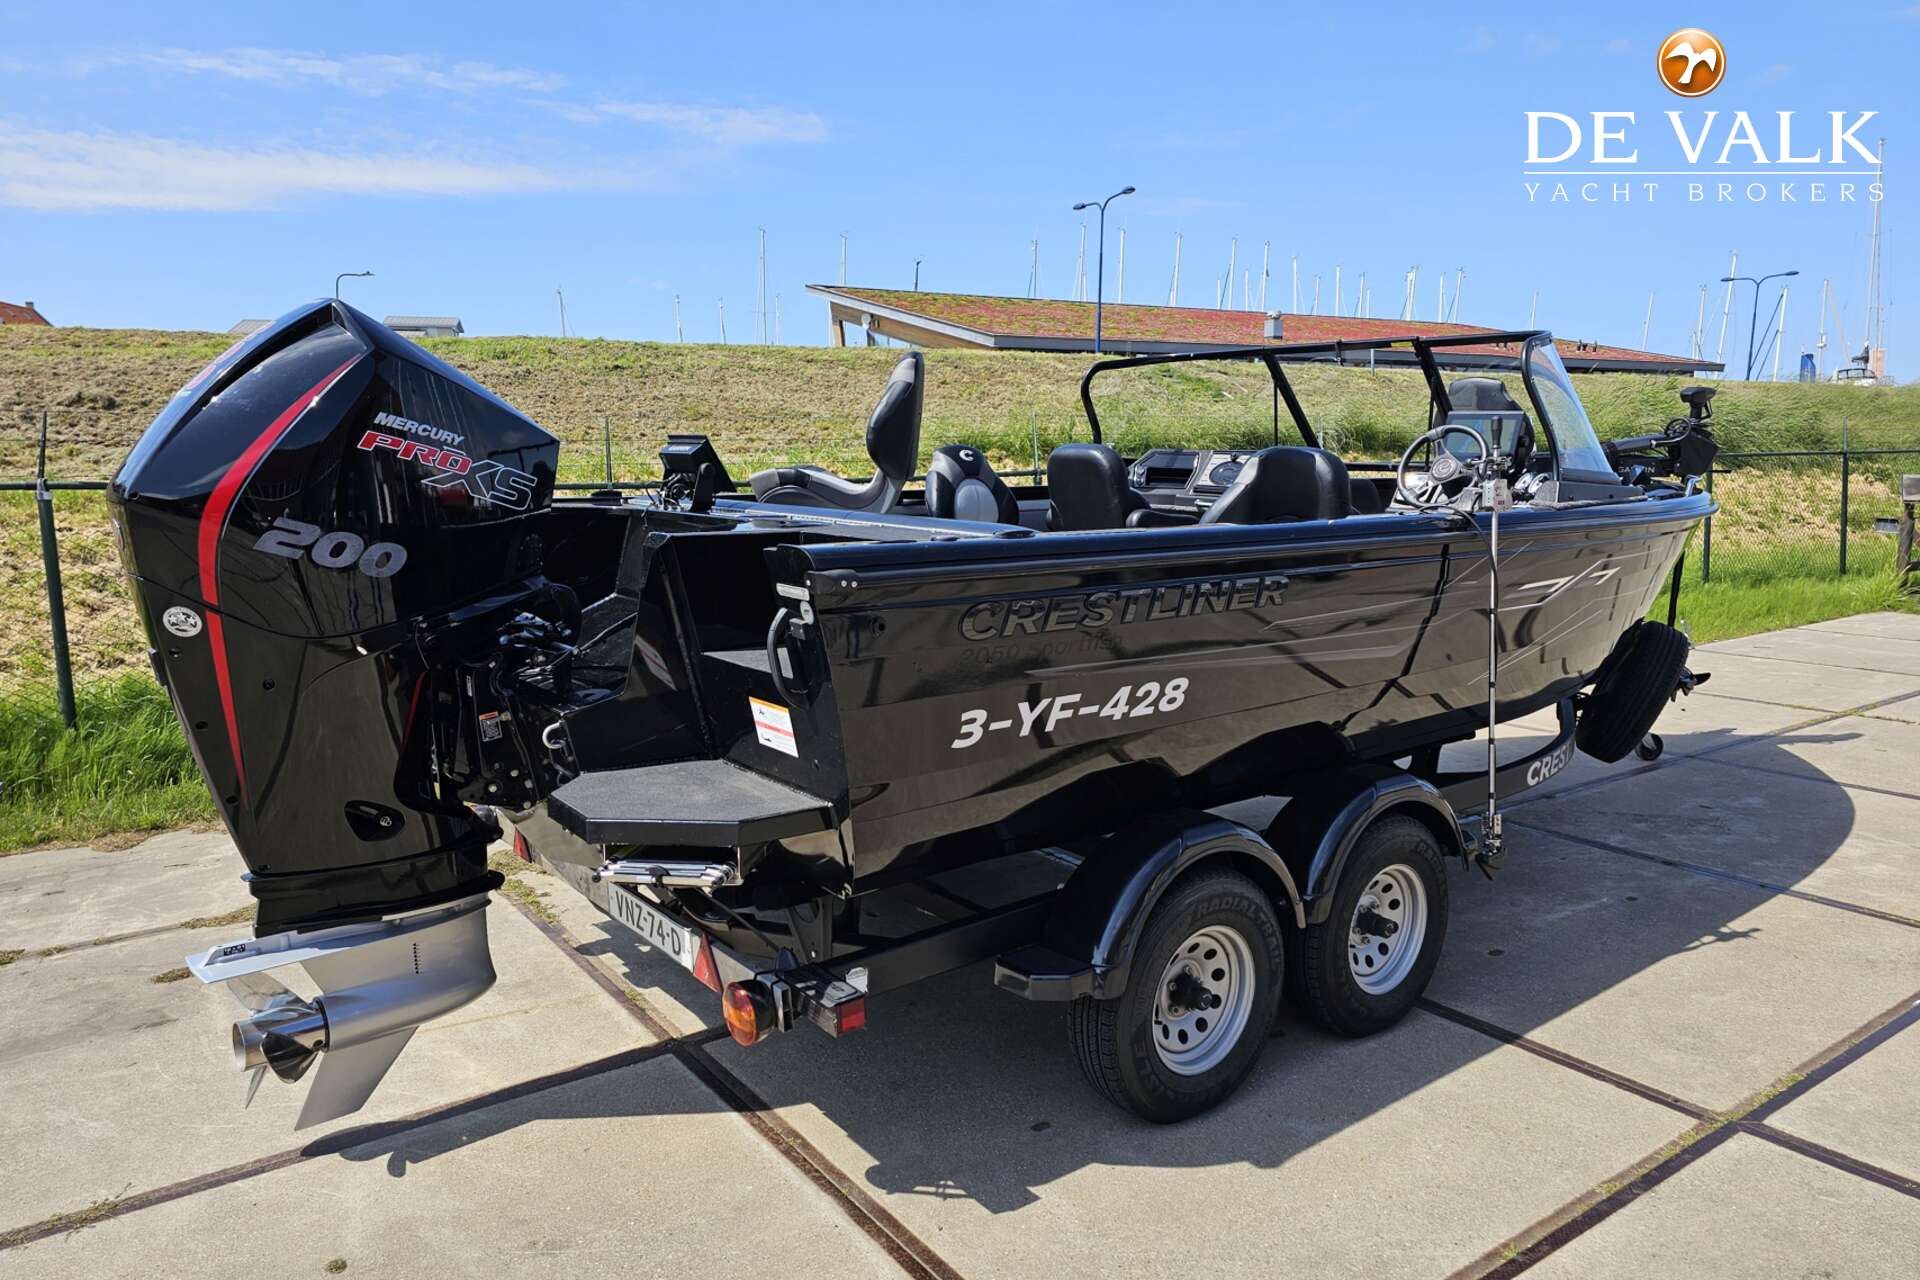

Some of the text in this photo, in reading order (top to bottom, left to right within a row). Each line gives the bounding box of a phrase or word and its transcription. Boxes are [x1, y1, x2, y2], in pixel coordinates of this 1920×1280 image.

[373, 411, 465, 446] MERCURY
[253, 516, 408, 578] 200
[958, 575, 1291, 641] CRESTLINER
[951, 677, 1190, 749] 3-YF-428
[615, 890, 682, 956] VNZ-74-D
